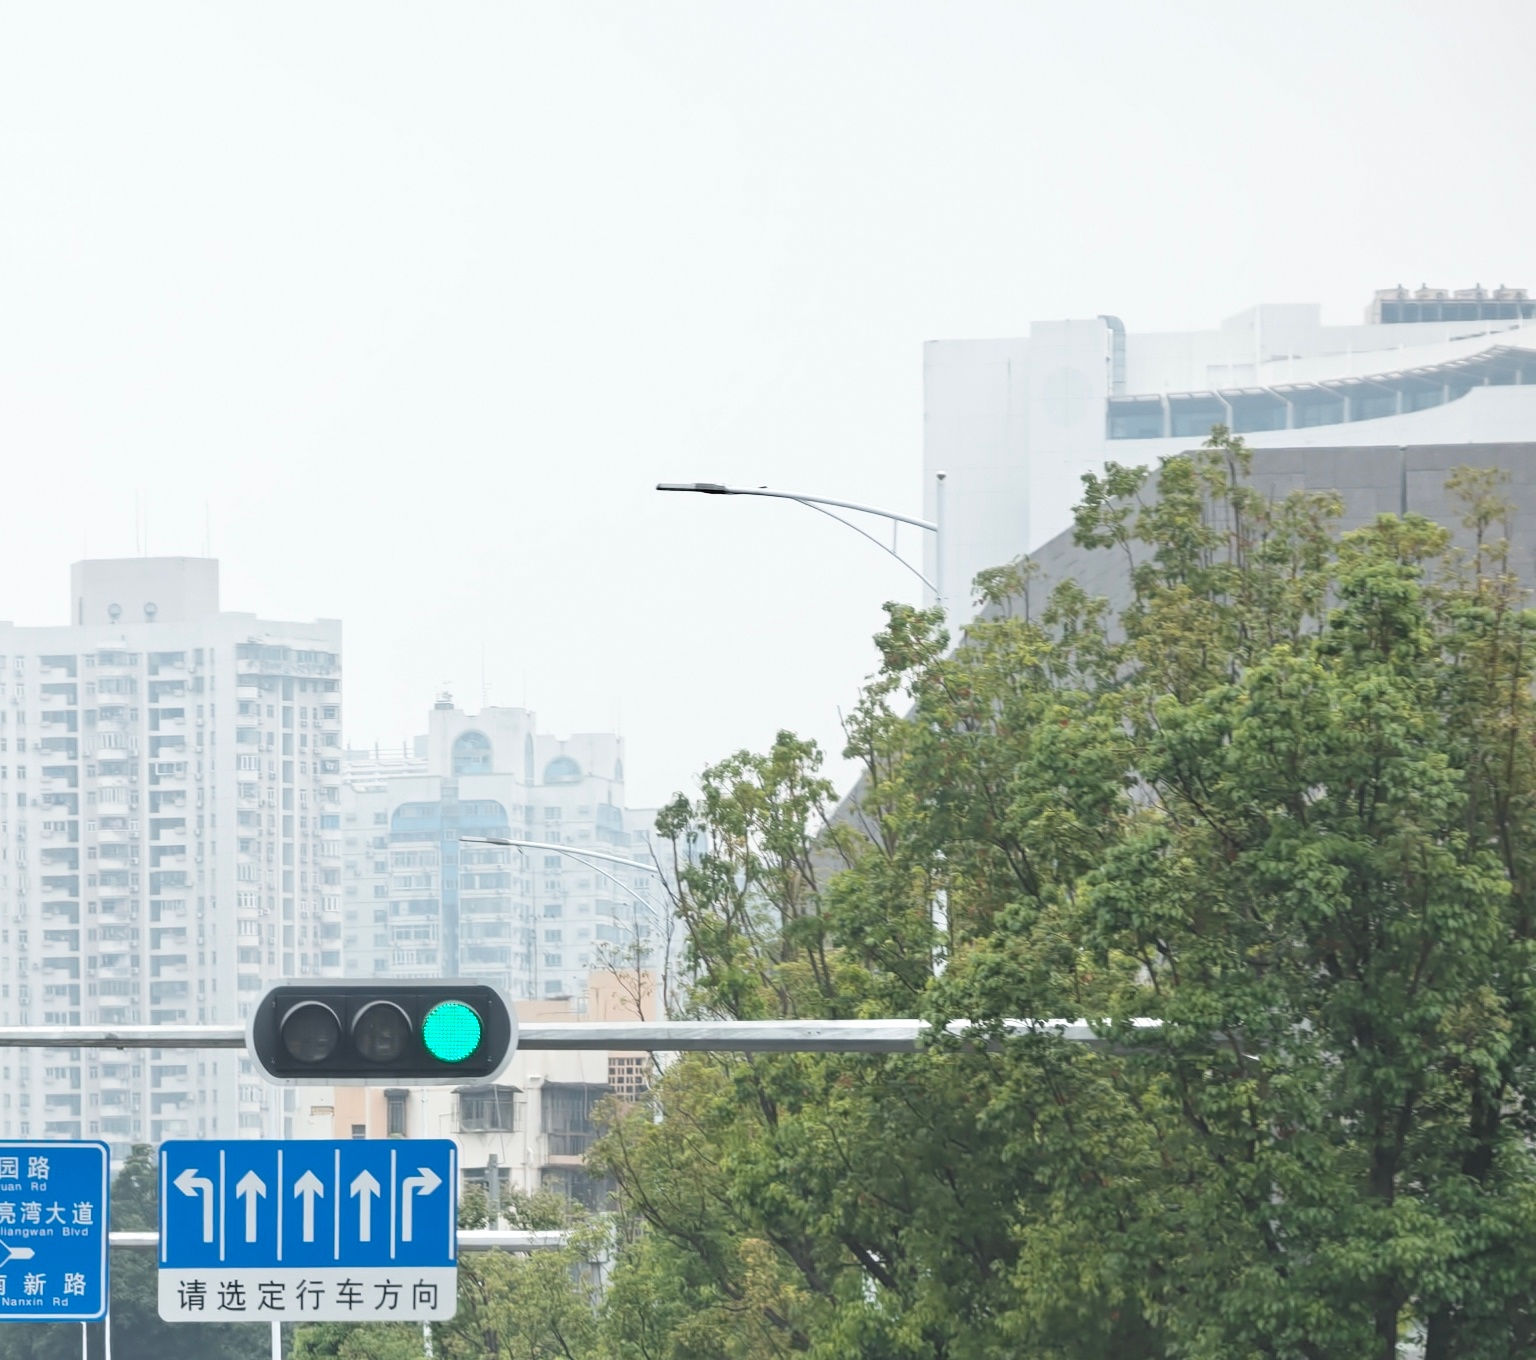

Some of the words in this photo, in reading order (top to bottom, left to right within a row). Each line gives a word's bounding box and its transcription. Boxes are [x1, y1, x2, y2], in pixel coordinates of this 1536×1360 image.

[31, 1181, 47, 1192] Rd
[62, 1226, 89, 1237] Blvd
[177, 1278, 438, 1312] 请选定行车方向
[2, 1297, 44, 1307] Nanxin
[53, 1297, 69, 1307] Rd
